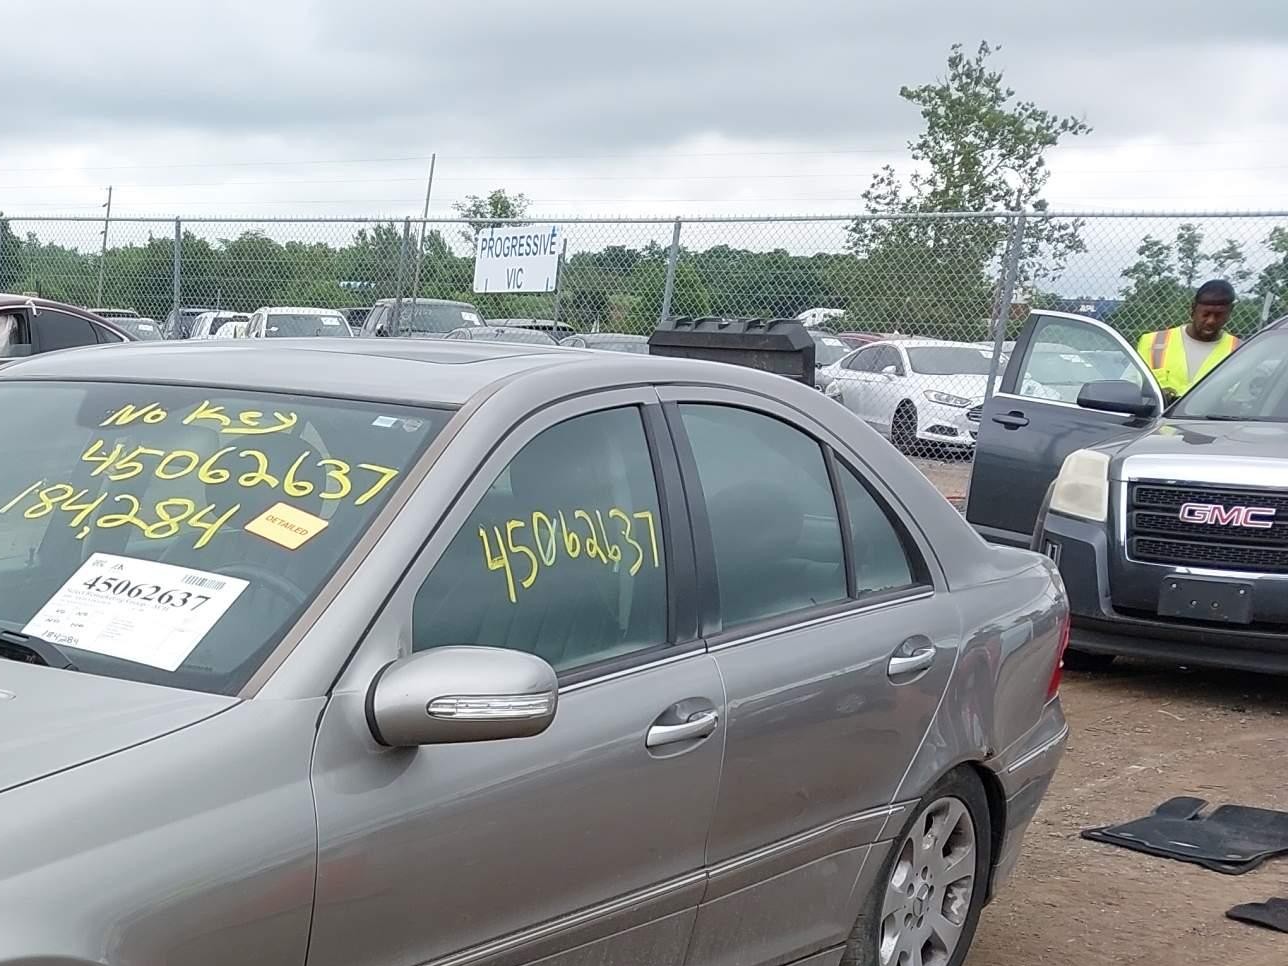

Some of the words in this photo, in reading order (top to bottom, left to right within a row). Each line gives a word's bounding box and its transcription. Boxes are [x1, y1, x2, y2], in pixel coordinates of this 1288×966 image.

[479, 233, 557, 259] PROGRESSIVE
[506, 267, 524, 290] VIC
[81, 439, 400, 506] 45062637
[0, 479, 241, 550] 184,284
[265, 514, 309, 536] DETAILED
[1179, 502, 1277, 529] GMC
[478, 508, 660, 603] 45062637
[83, 575, 211, 612] 45062637
